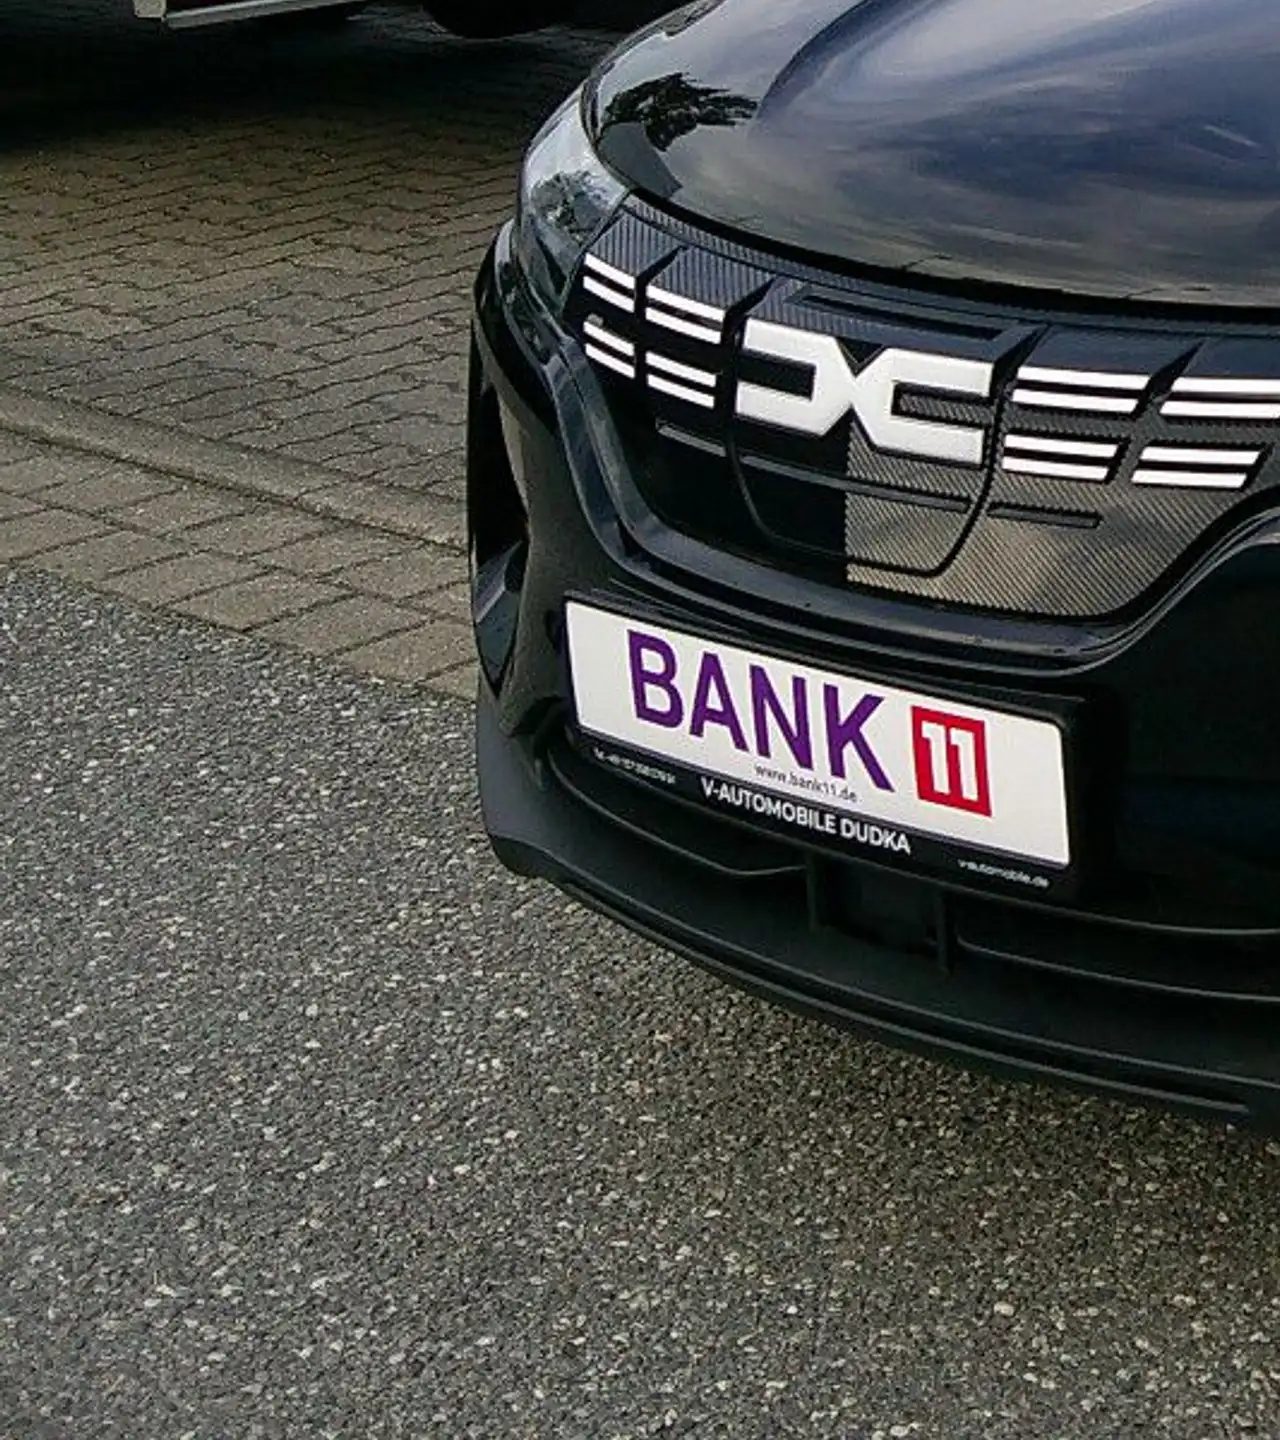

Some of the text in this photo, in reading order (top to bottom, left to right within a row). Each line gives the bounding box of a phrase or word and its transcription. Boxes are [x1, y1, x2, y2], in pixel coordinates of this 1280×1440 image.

[627, 628, 981, 804] BANK 11
[701, 776, 911, 856] V-AUTOMOBILE DUDKA
